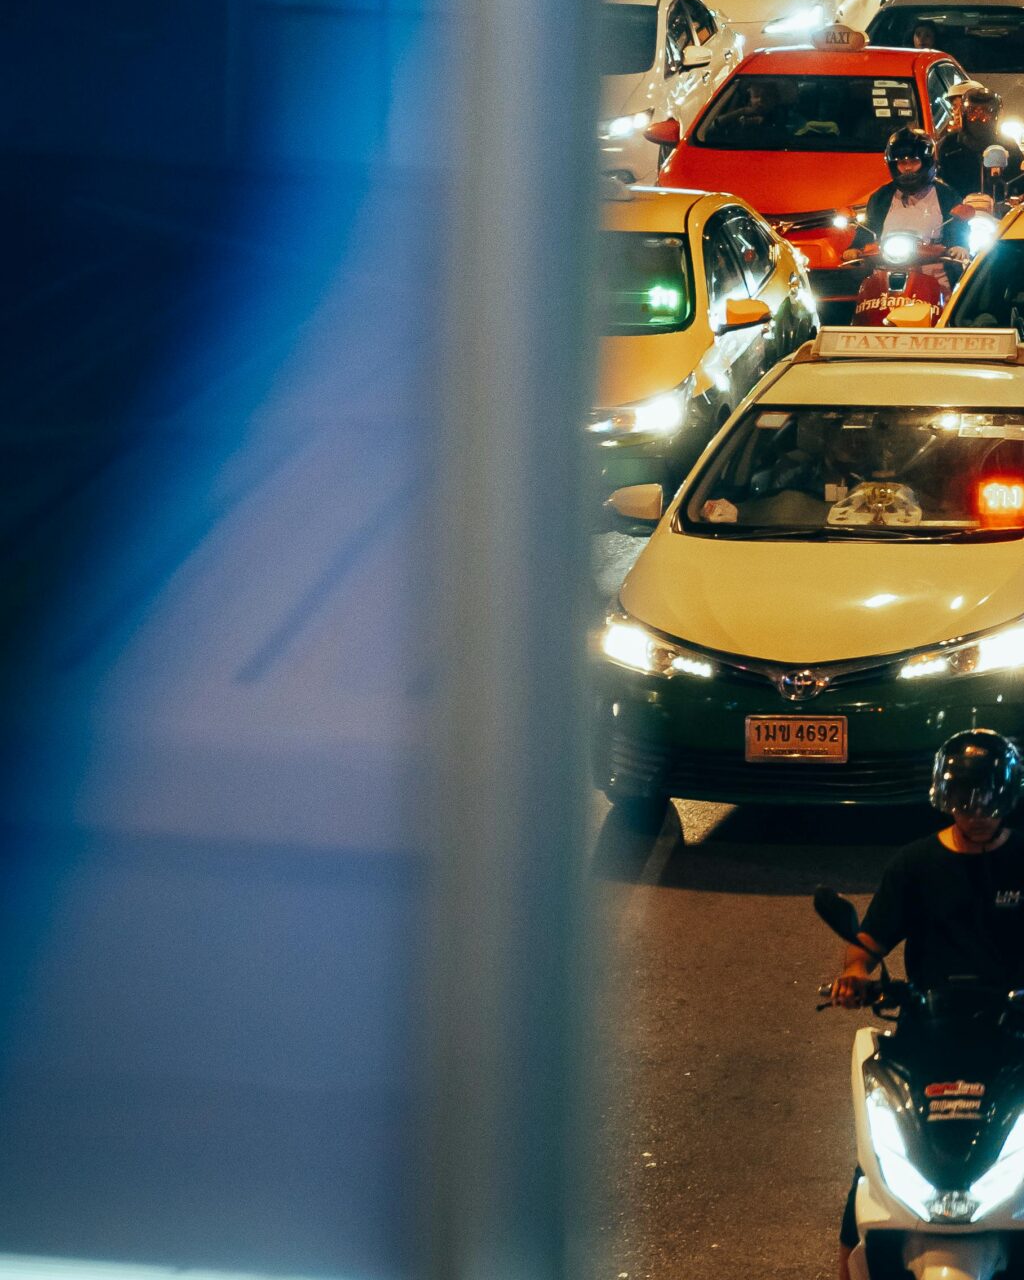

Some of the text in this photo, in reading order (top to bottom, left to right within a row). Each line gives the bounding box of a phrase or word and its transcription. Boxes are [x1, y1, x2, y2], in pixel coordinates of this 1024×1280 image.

[825, 31, 849, 45] TAXI
[841, 334, 997, 352] TAXI-METER
[795, 724, 839, 742] 4692
